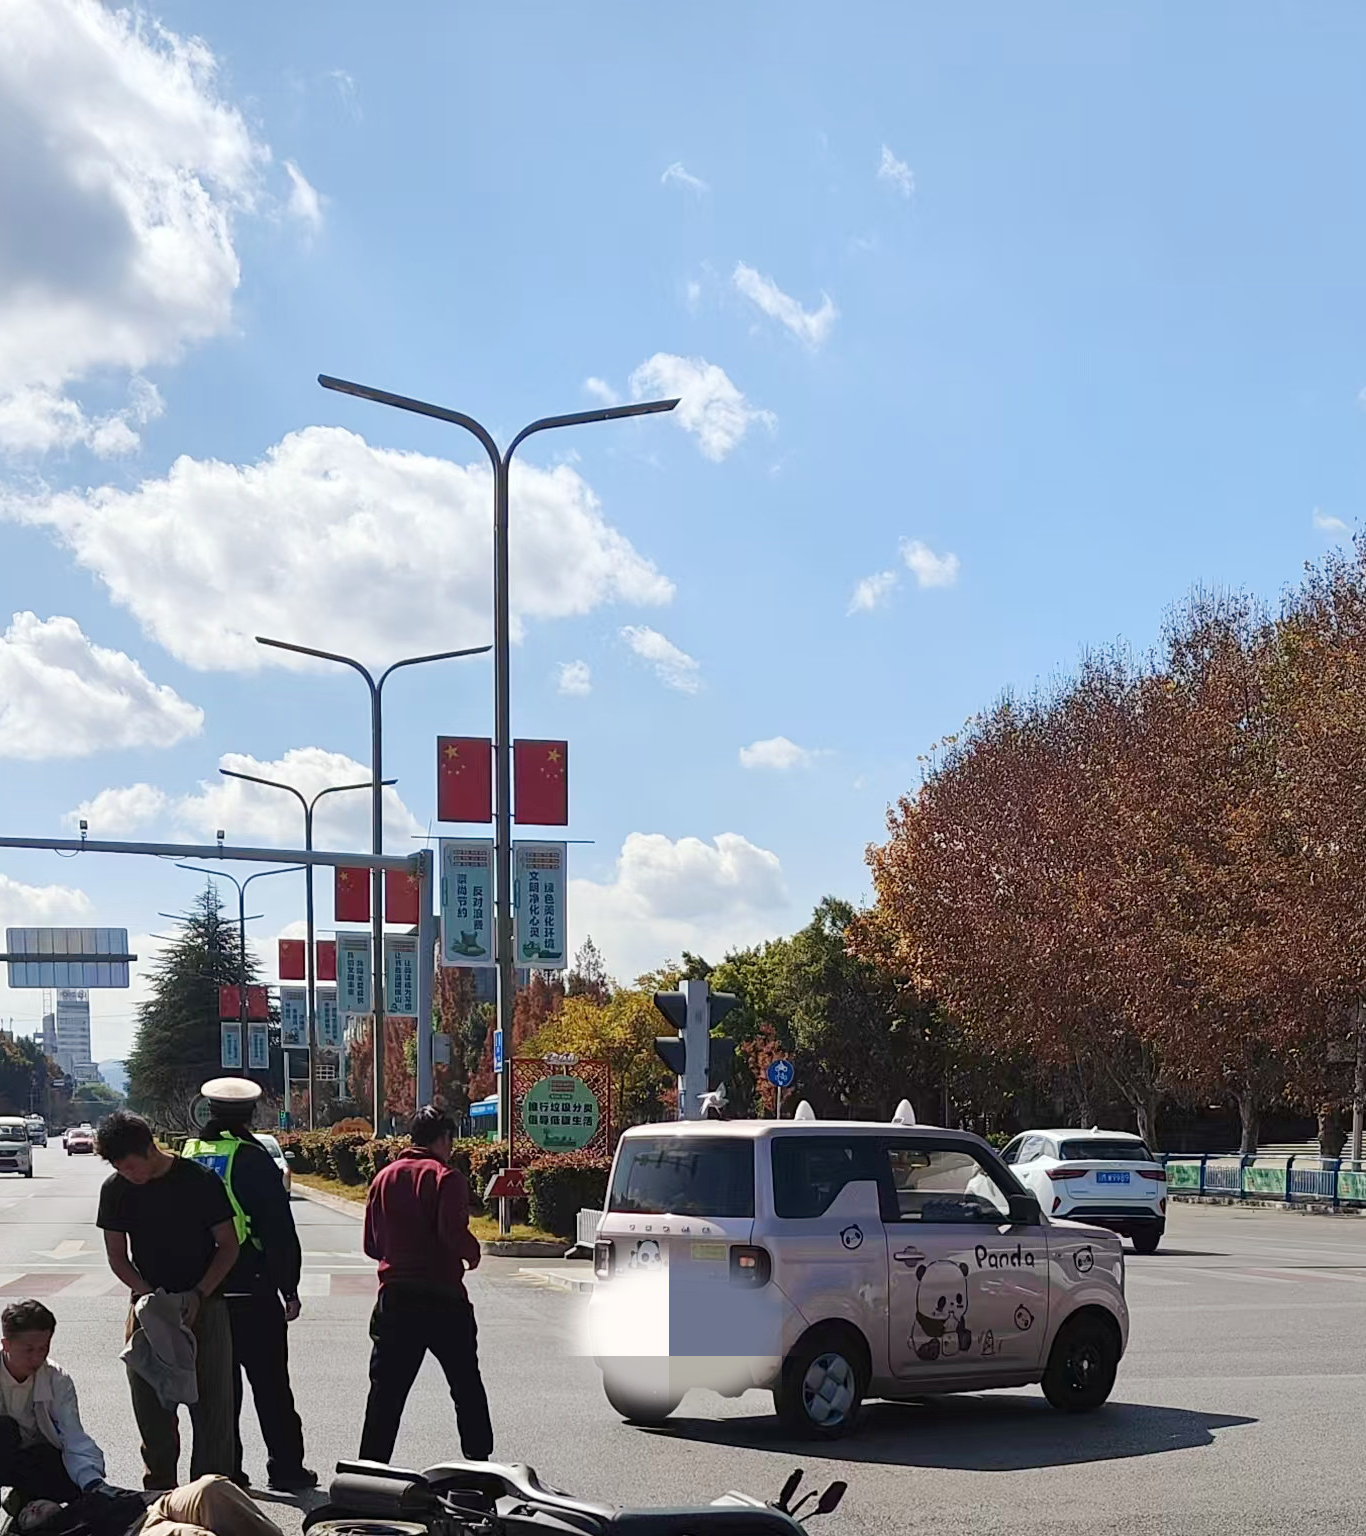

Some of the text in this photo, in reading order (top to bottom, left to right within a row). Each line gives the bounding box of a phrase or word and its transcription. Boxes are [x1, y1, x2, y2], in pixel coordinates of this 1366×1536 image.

[473, 886, 484, 931] 反对浪费
[529, 871, 540, 938] 文明净化心灵
[544, 882, 555, 949] 绿色美化环境
[528, 1102, 593, 1113] 推行垃圾分类
[528, 1115, 593, 1127] 倡导低碳生活
[975, 1243, 1035, 1269] Panda
